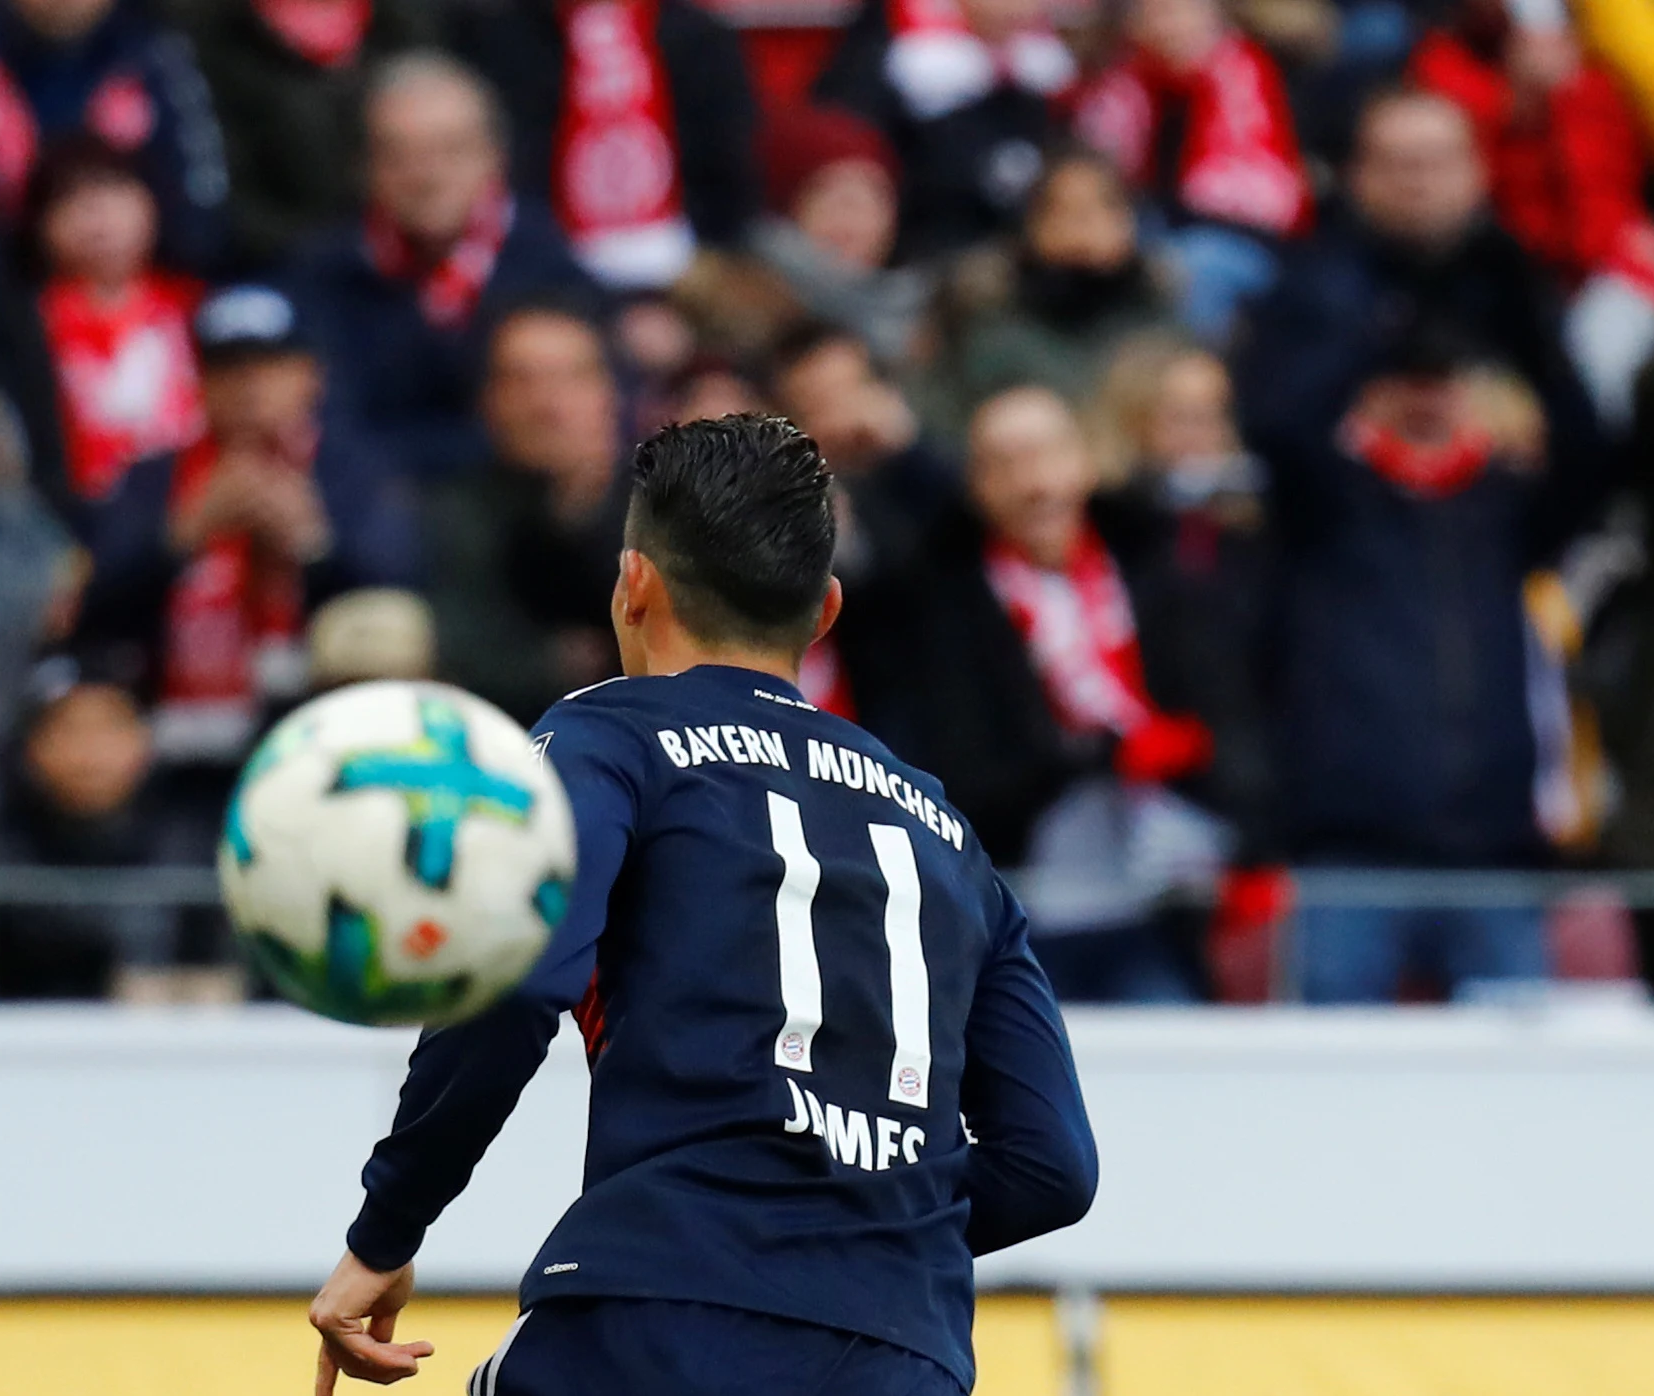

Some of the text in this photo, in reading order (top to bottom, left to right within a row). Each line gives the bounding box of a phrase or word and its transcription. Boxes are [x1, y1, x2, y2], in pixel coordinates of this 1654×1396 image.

[657, 725, 964, 851] BAYERN MÜNCHEN
[766, 790, 931, 1109] 11
